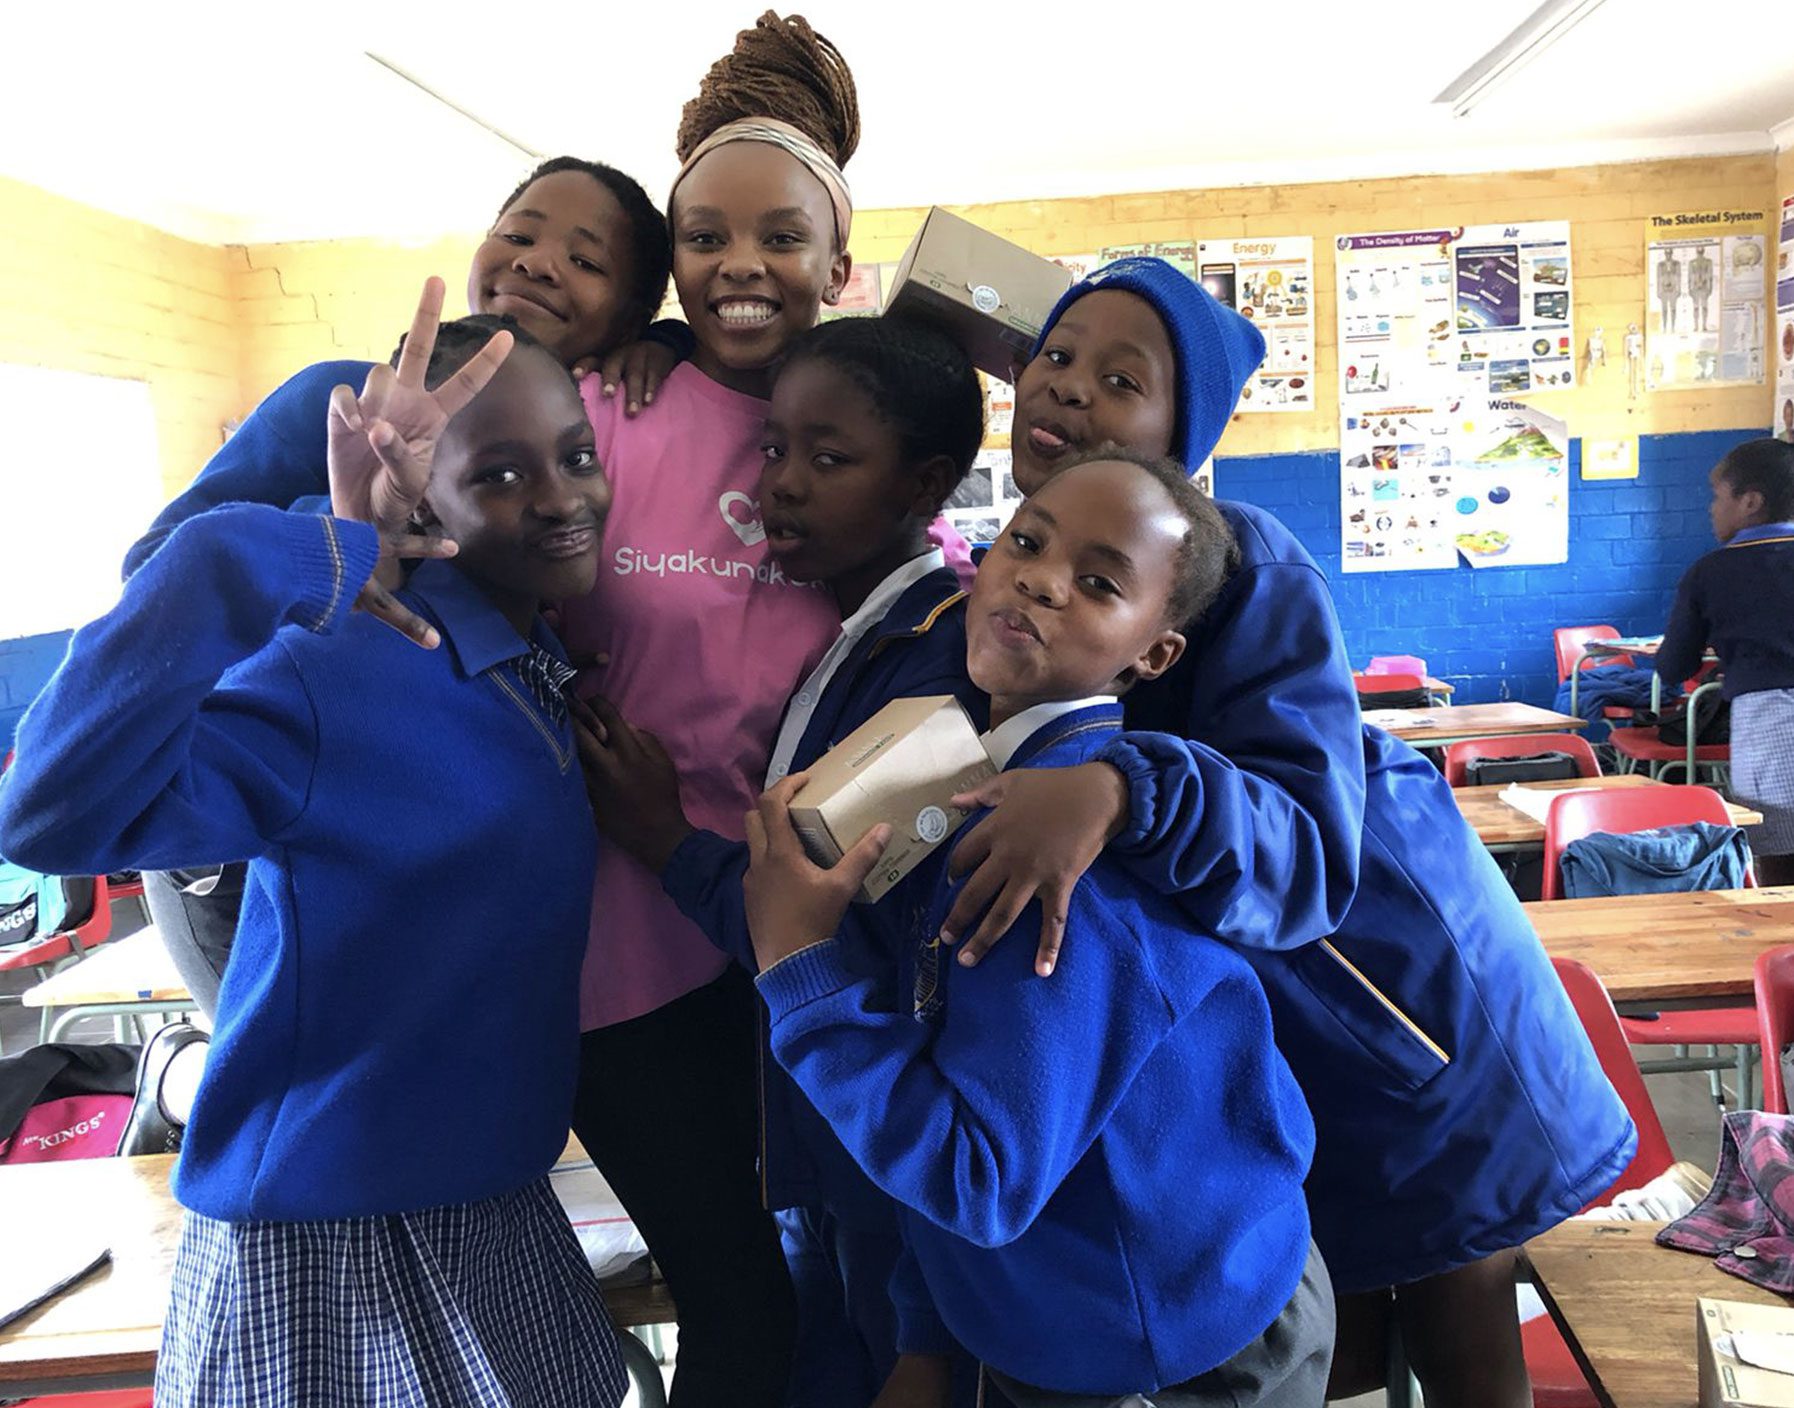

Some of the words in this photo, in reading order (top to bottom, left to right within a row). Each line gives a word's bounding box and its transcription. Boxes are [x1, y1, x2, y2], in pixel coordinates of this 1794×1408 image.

[1651, 216, 1673, 227] The
[1675, 212, 1721, 226] Skeletal
[1723, 211, 1764, 224] System
[1503, 227, 1520, 238] Air
[1359, 237, 1375, 247] The
[1375, 236, 1405, 247] Density
[1405, 235, 1414, 244] of
[1414, 234, 1441, 244] Matter
[1138, 243, 1151, 256] of
[1233, 242, 1277, 255] Energy
[1488, 400, 1528, 411] Water
